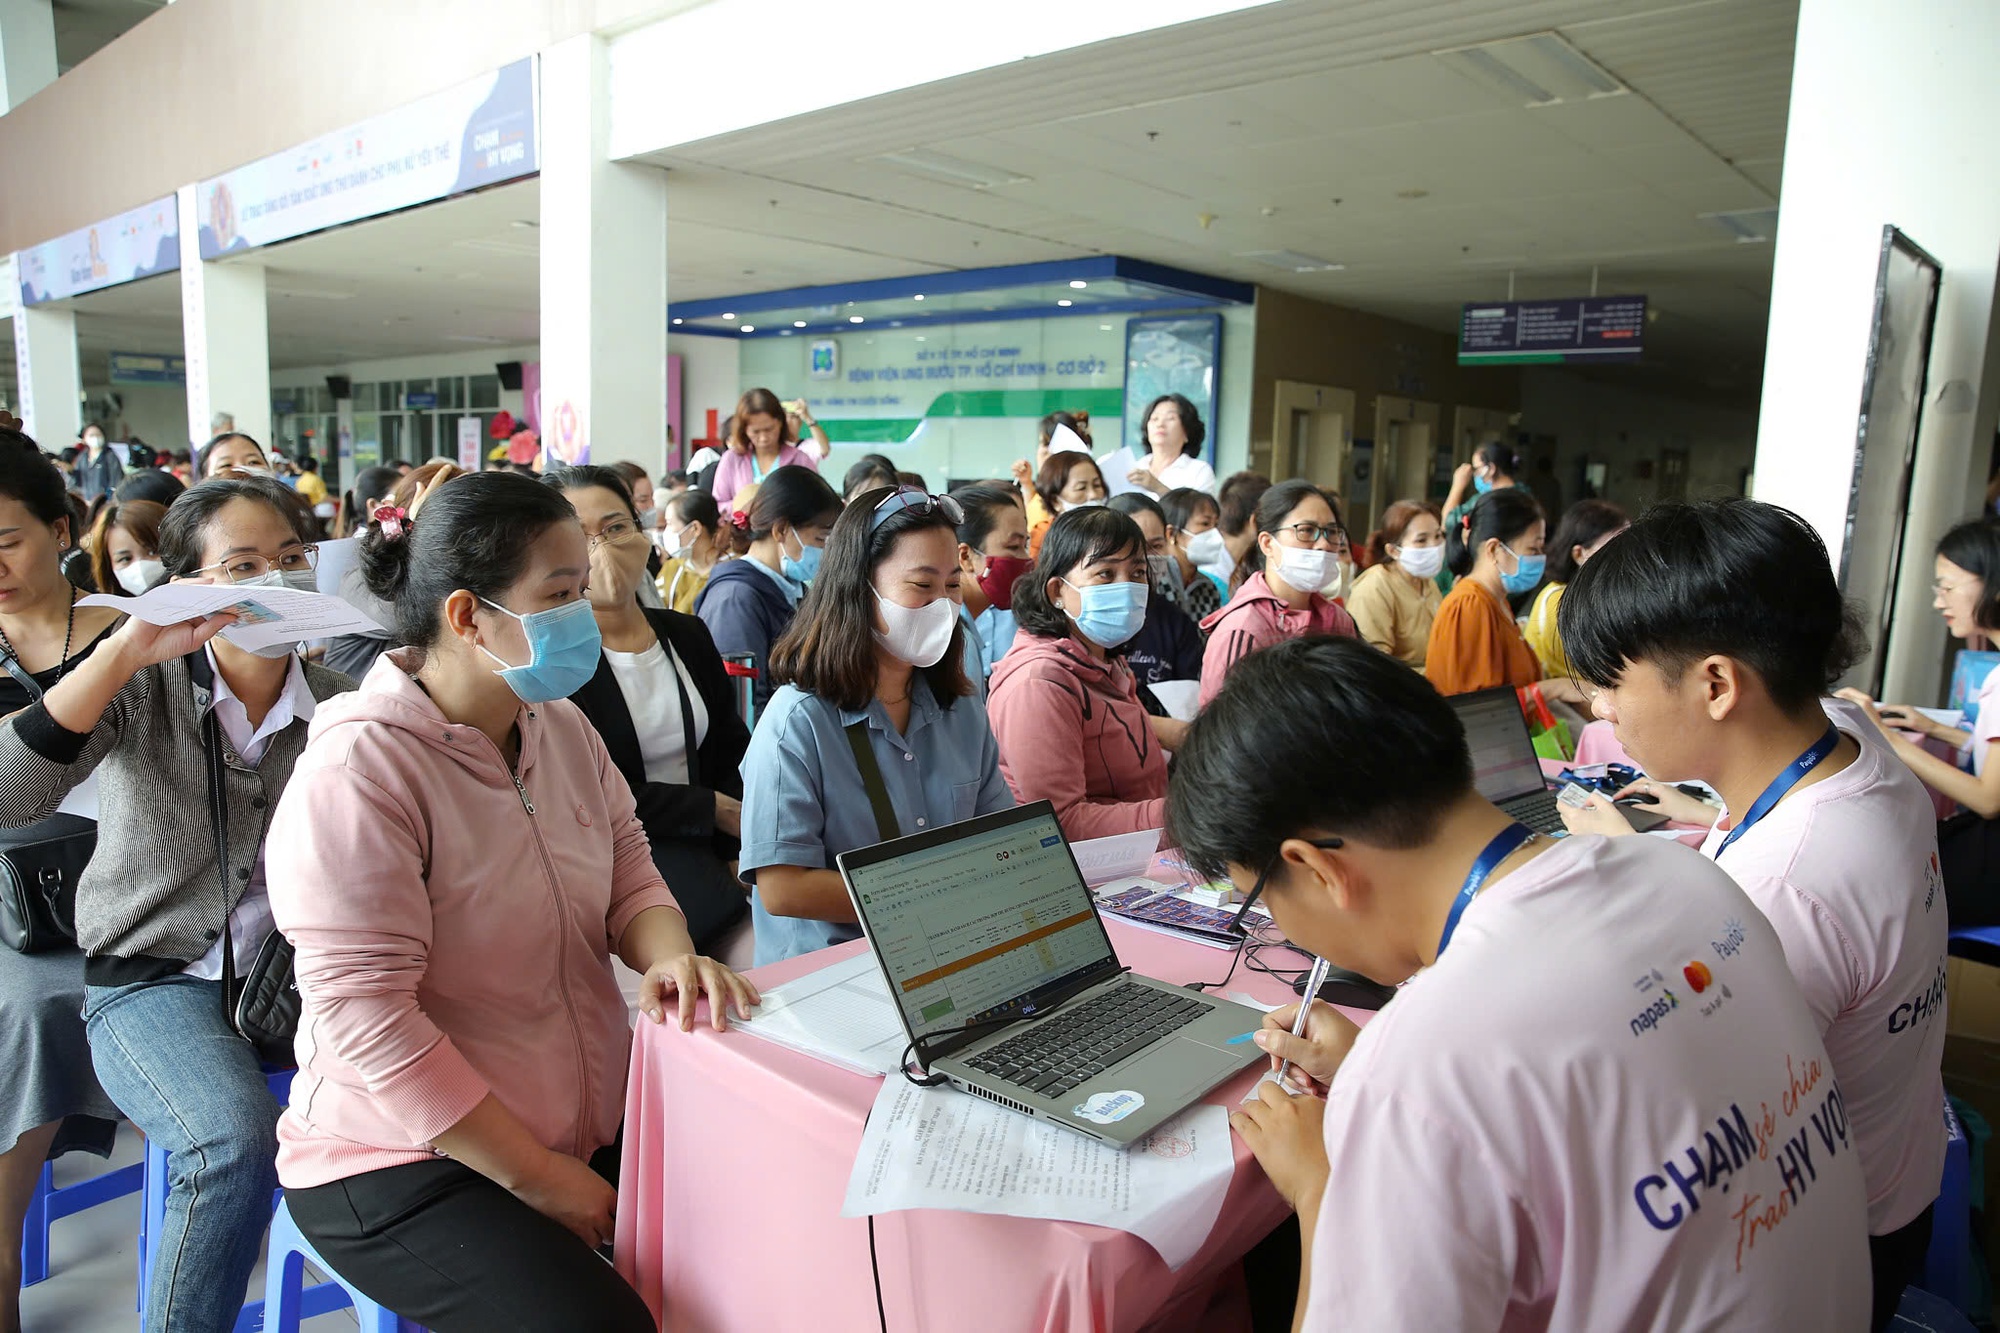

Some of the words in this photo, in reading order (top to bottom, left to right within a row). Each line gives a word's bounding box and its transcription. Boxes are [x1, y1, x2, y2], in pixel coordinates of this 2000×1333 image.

[1711, 928, 1745, 961] Payoo
[1022, 1003, 1037, 1015] DELL
[1629, 995, 1673, 1037] napas
[1633, 1102, 1757, 1231] CHẠM
[1783, 1054, 1821, 1117] chia
[1731, 1168, 1794, 1274] trao
[1776, 1126, 1816, 1206] HY
